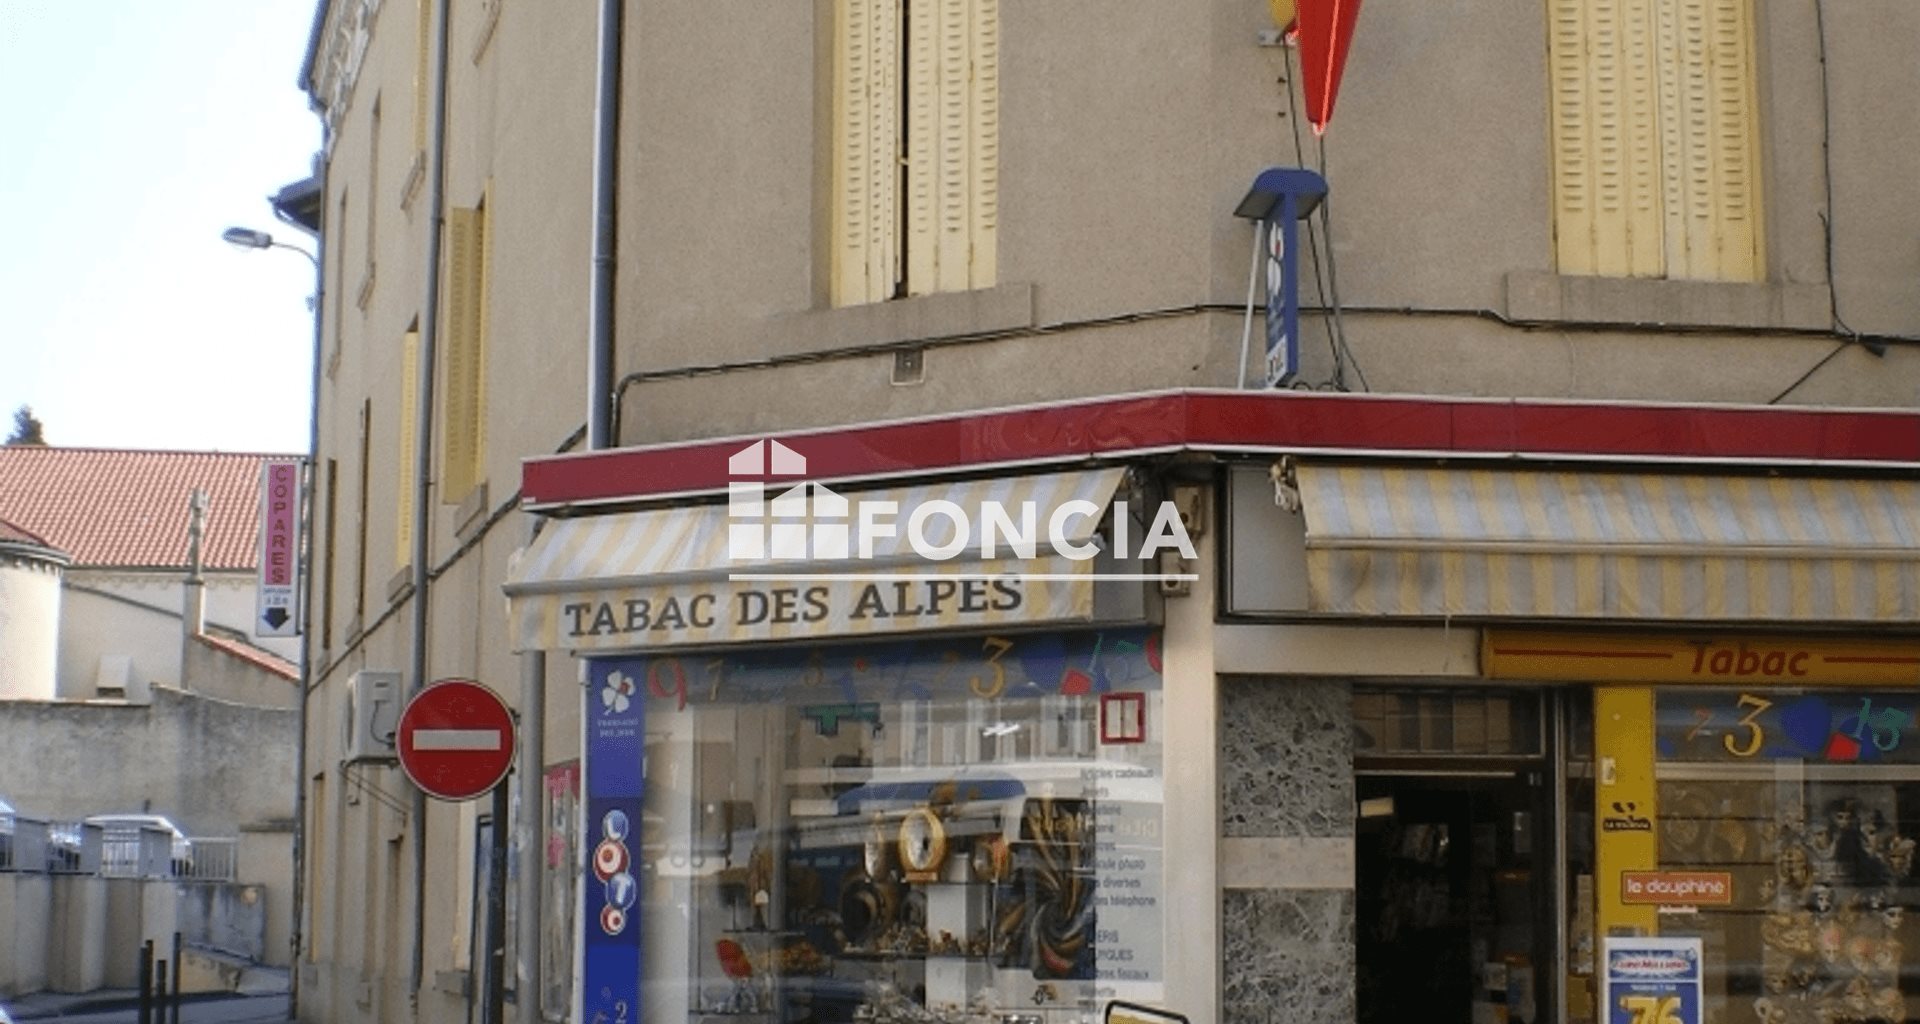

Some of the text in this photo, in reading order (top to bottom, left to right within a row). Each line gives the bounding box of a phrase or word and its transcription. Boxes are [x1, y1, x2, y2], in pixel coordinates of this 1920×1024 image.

[271, 465, 288, 584] COPARES
[565, 574, 1023, 638] TABAC DES ALPES
[1689, 640, 1810, 677] Tabac
[1724, 693, 1774, 757] 3
[1627, 878, 1642, 894] le
